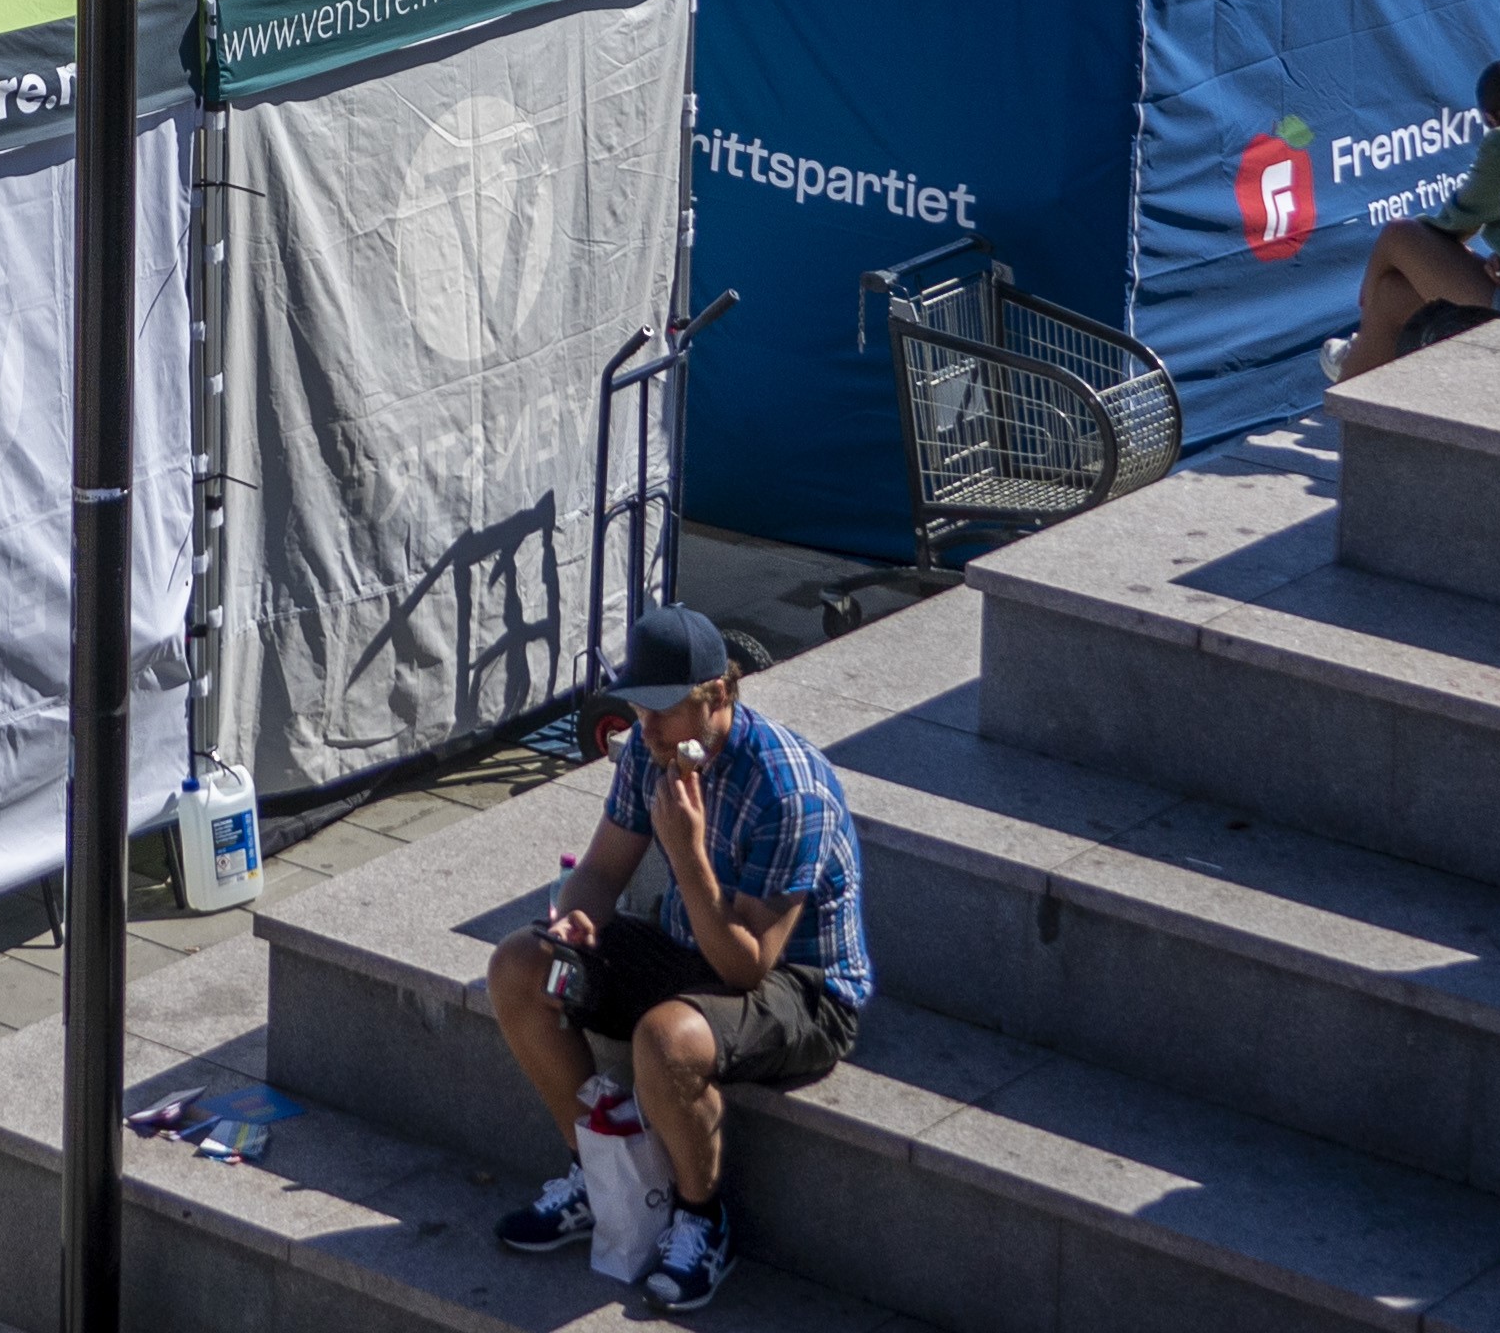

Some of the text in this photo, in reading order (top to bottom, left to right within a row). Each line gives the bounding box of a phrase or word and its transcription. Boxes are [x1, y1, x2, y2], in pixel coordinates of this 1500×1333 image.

[692, 128, 978, 231] rittspartiet
[1368, 168, 1471, 213] mer frihe
